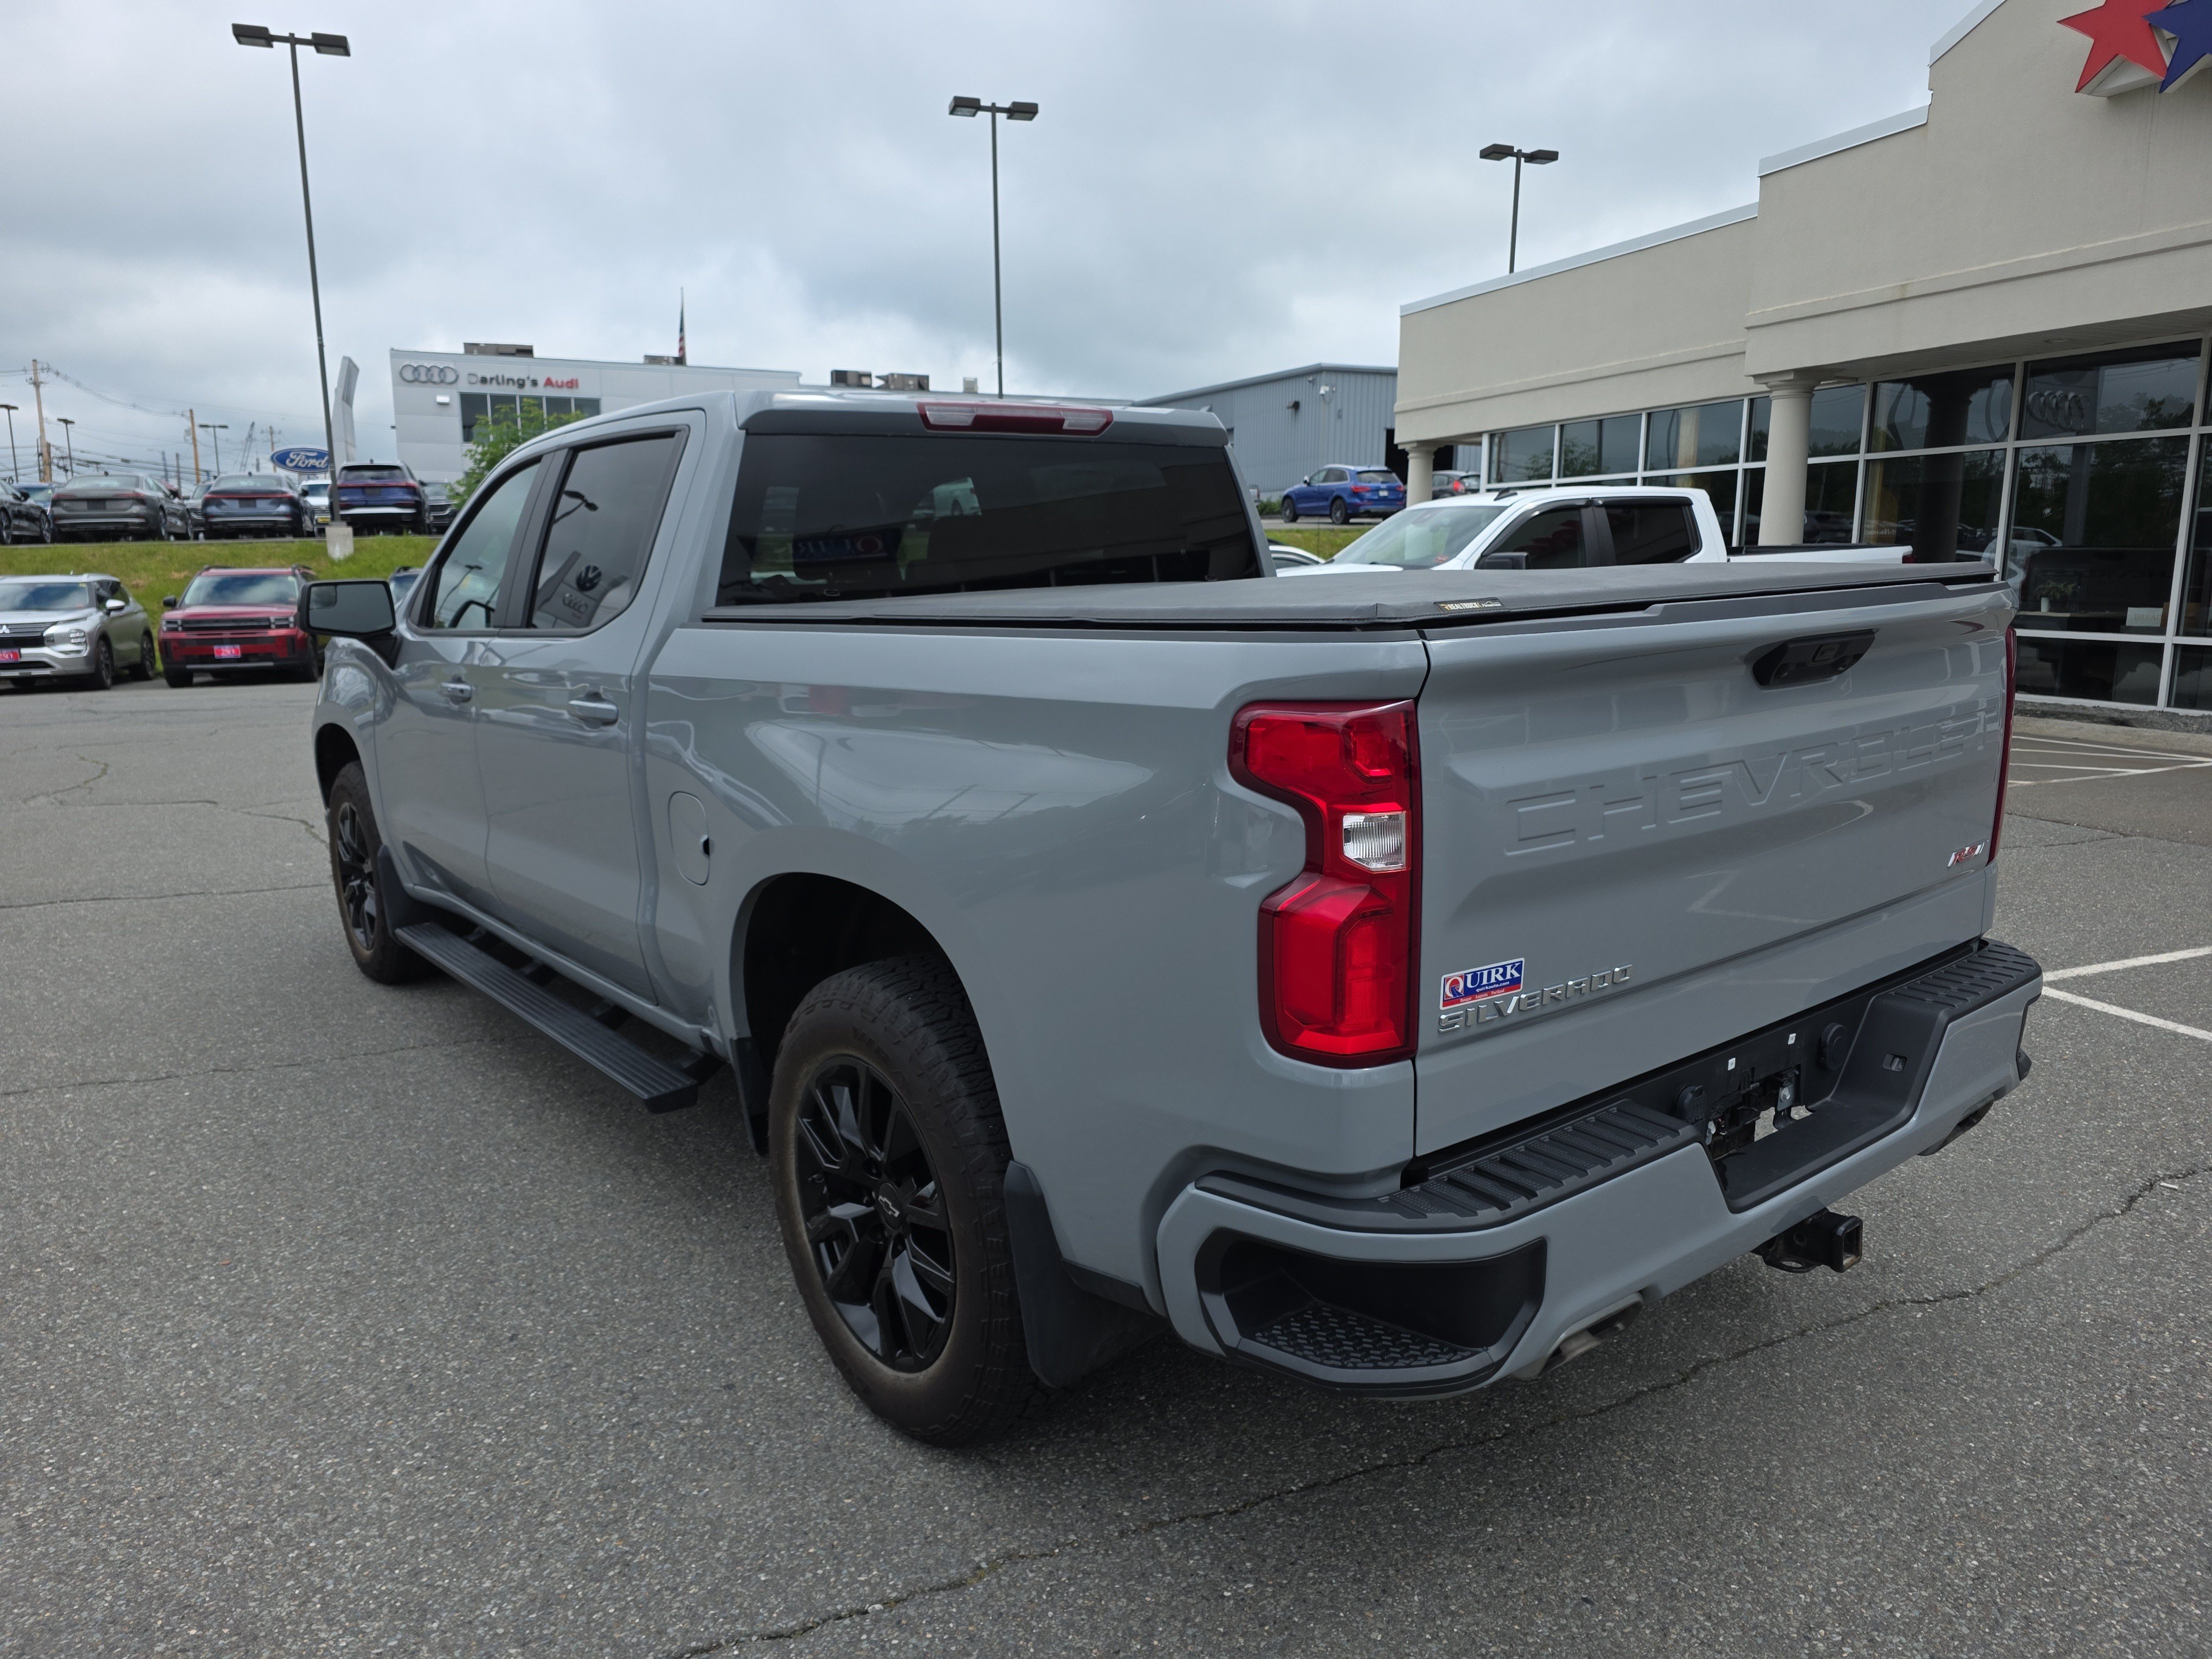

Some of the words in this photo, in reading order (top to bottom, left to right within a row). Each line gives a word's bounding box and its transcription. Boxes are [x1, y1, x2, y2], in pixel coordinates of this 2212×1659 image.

[467, 372, 538, 389] Darling's
[544, 376, 579, 389] Audi
[286, 451, 329, 468] Ford
[1503, 705, 1997, 856] CHEVROLET
[1445, 962, 1521, 1000] QUIRK
[1476, 981, 1510, 992] quirkauto.com
[1438, 964, 1633, 1033] SILVERADO
